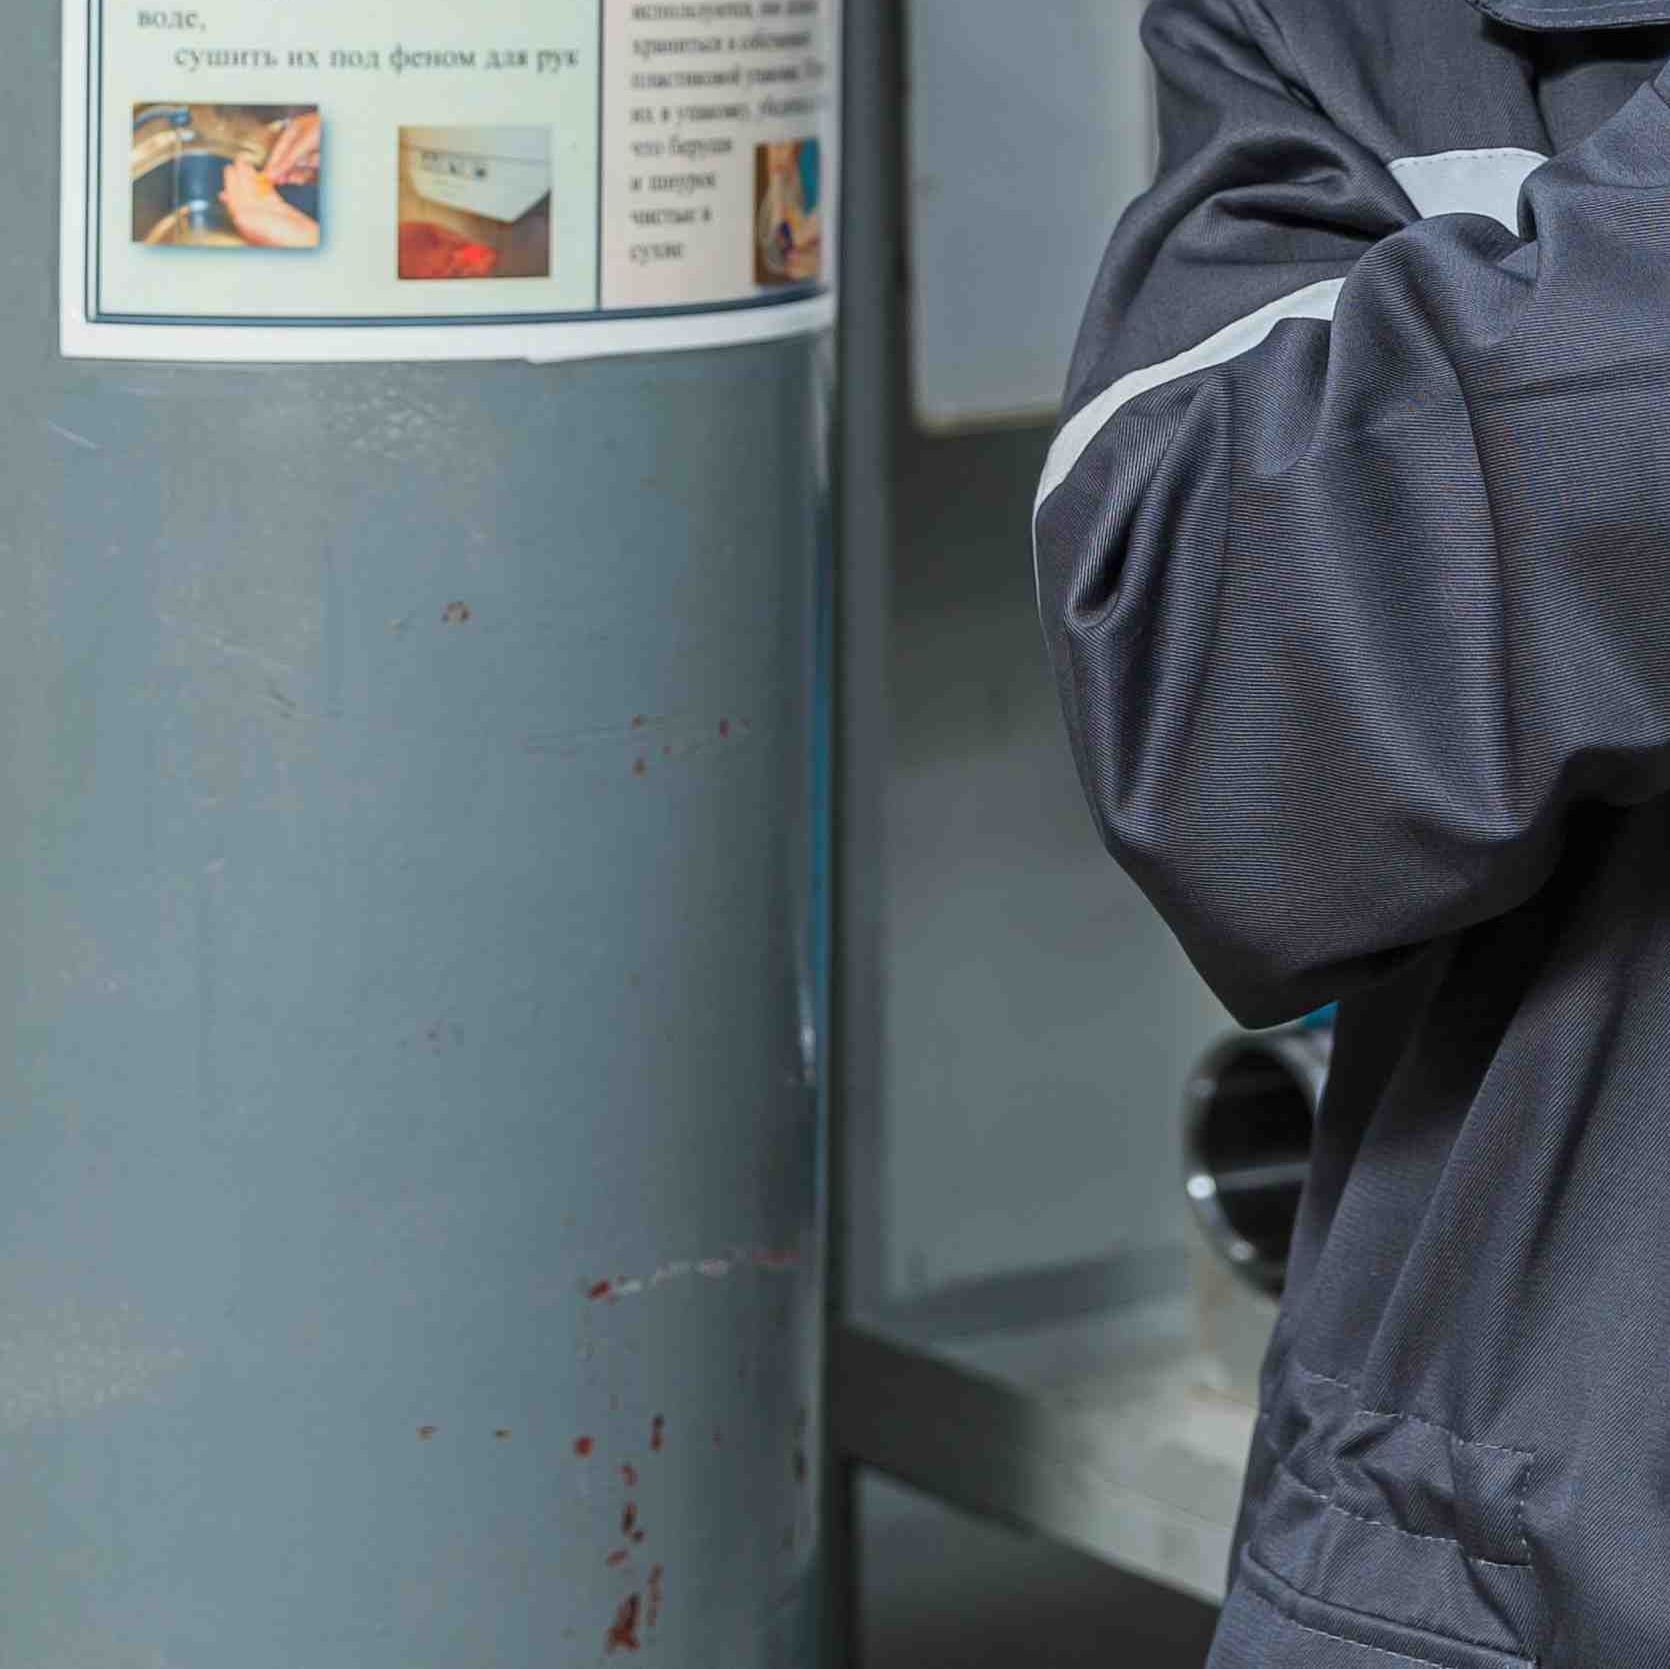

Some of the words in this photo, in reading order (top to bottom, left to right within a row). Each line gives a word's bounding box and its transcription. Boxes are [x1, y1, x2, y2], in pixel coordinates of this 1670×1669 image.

[137, 8, 207, 33] воде,
[173, 45, 279, 74] сушить
[287, 47, 319, 68] их
[329, 47, 380, 73] под
[389, 41, 476, 75] феном
[484, 47, 530, 69] для
[536, 47, 580, 75] рук
